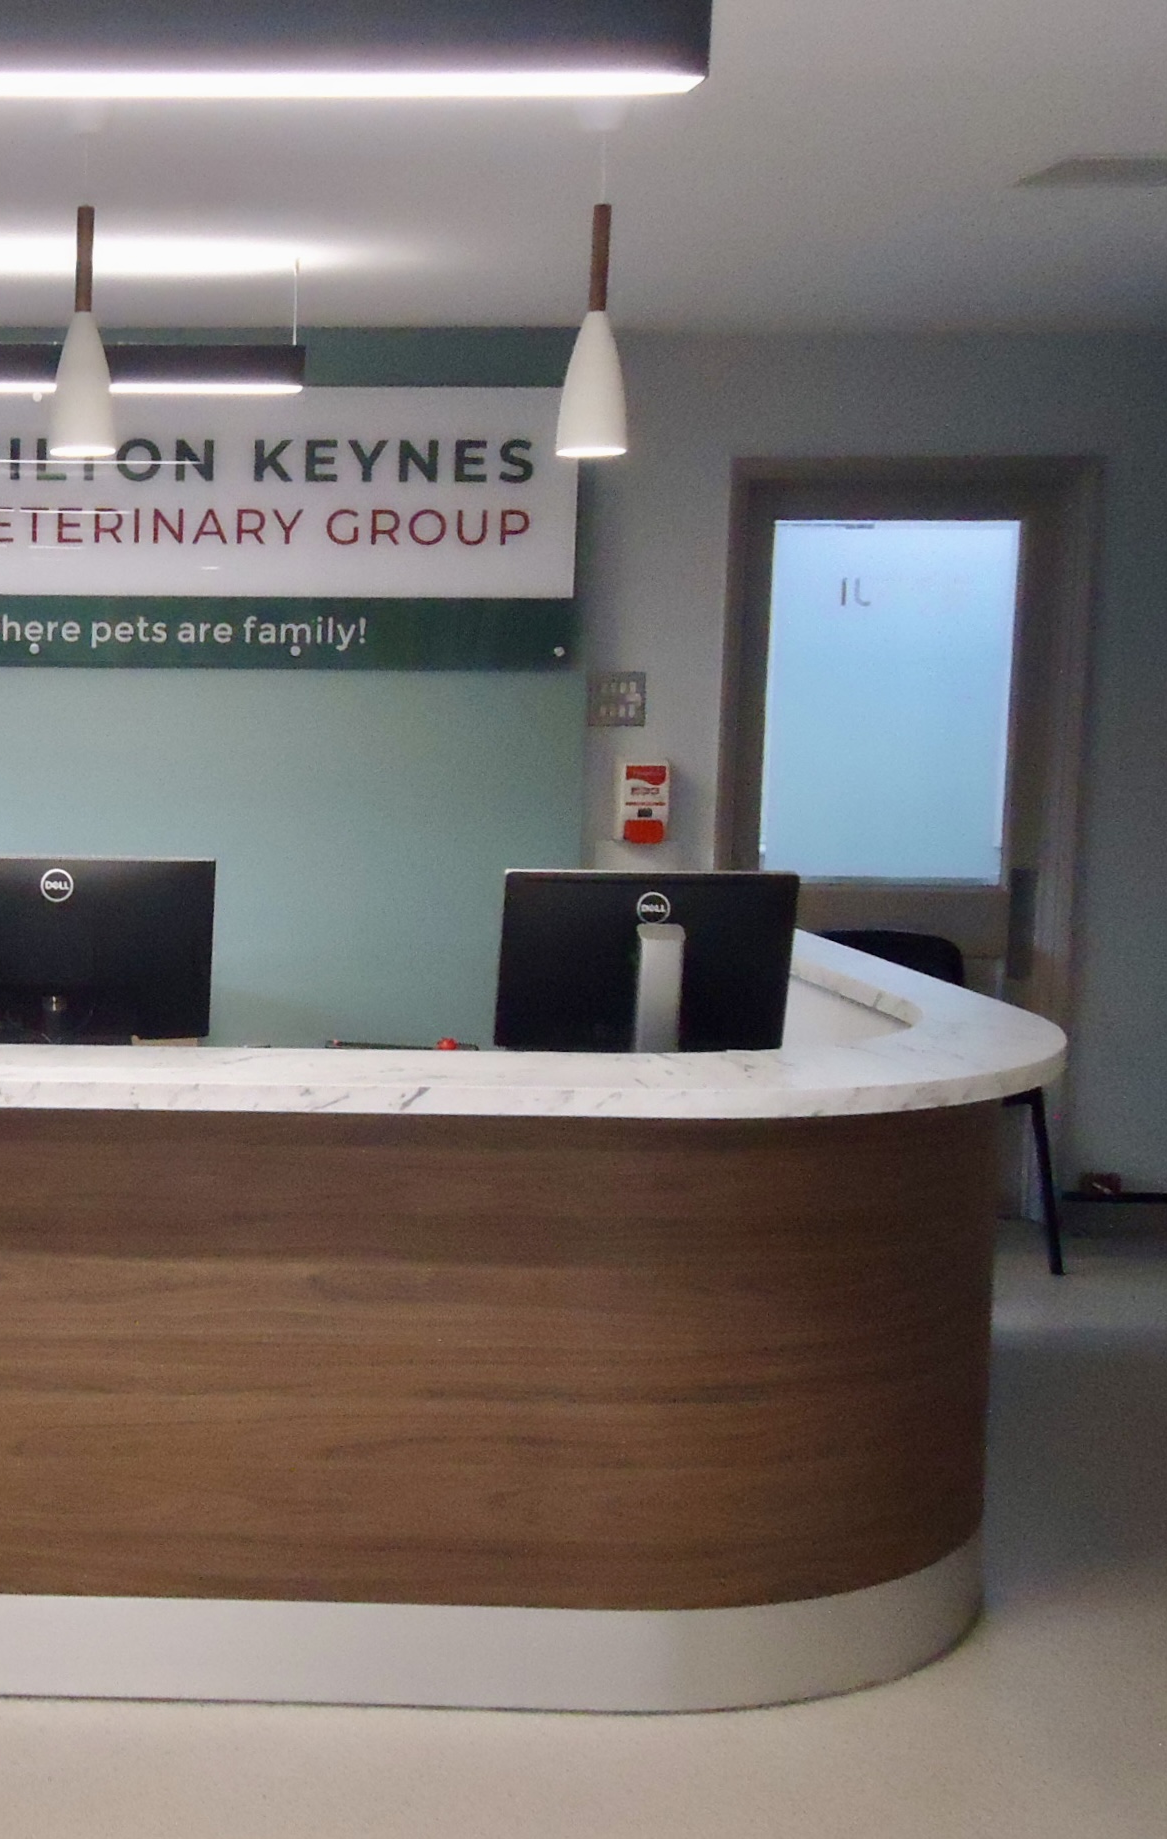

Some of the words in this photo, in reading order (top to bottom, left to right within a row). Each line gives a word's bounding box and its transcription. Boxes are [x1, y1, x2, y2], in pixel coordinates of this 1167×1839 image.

[253, 438, 534, 483] KEYNES
[326, 508, 531, 546] GROUP
[90, 616, 168, 648] pets
[177, 622, 233, 643] are
[243, 615, 367, 651] family!
[44, 880, 70, 890] DELL
